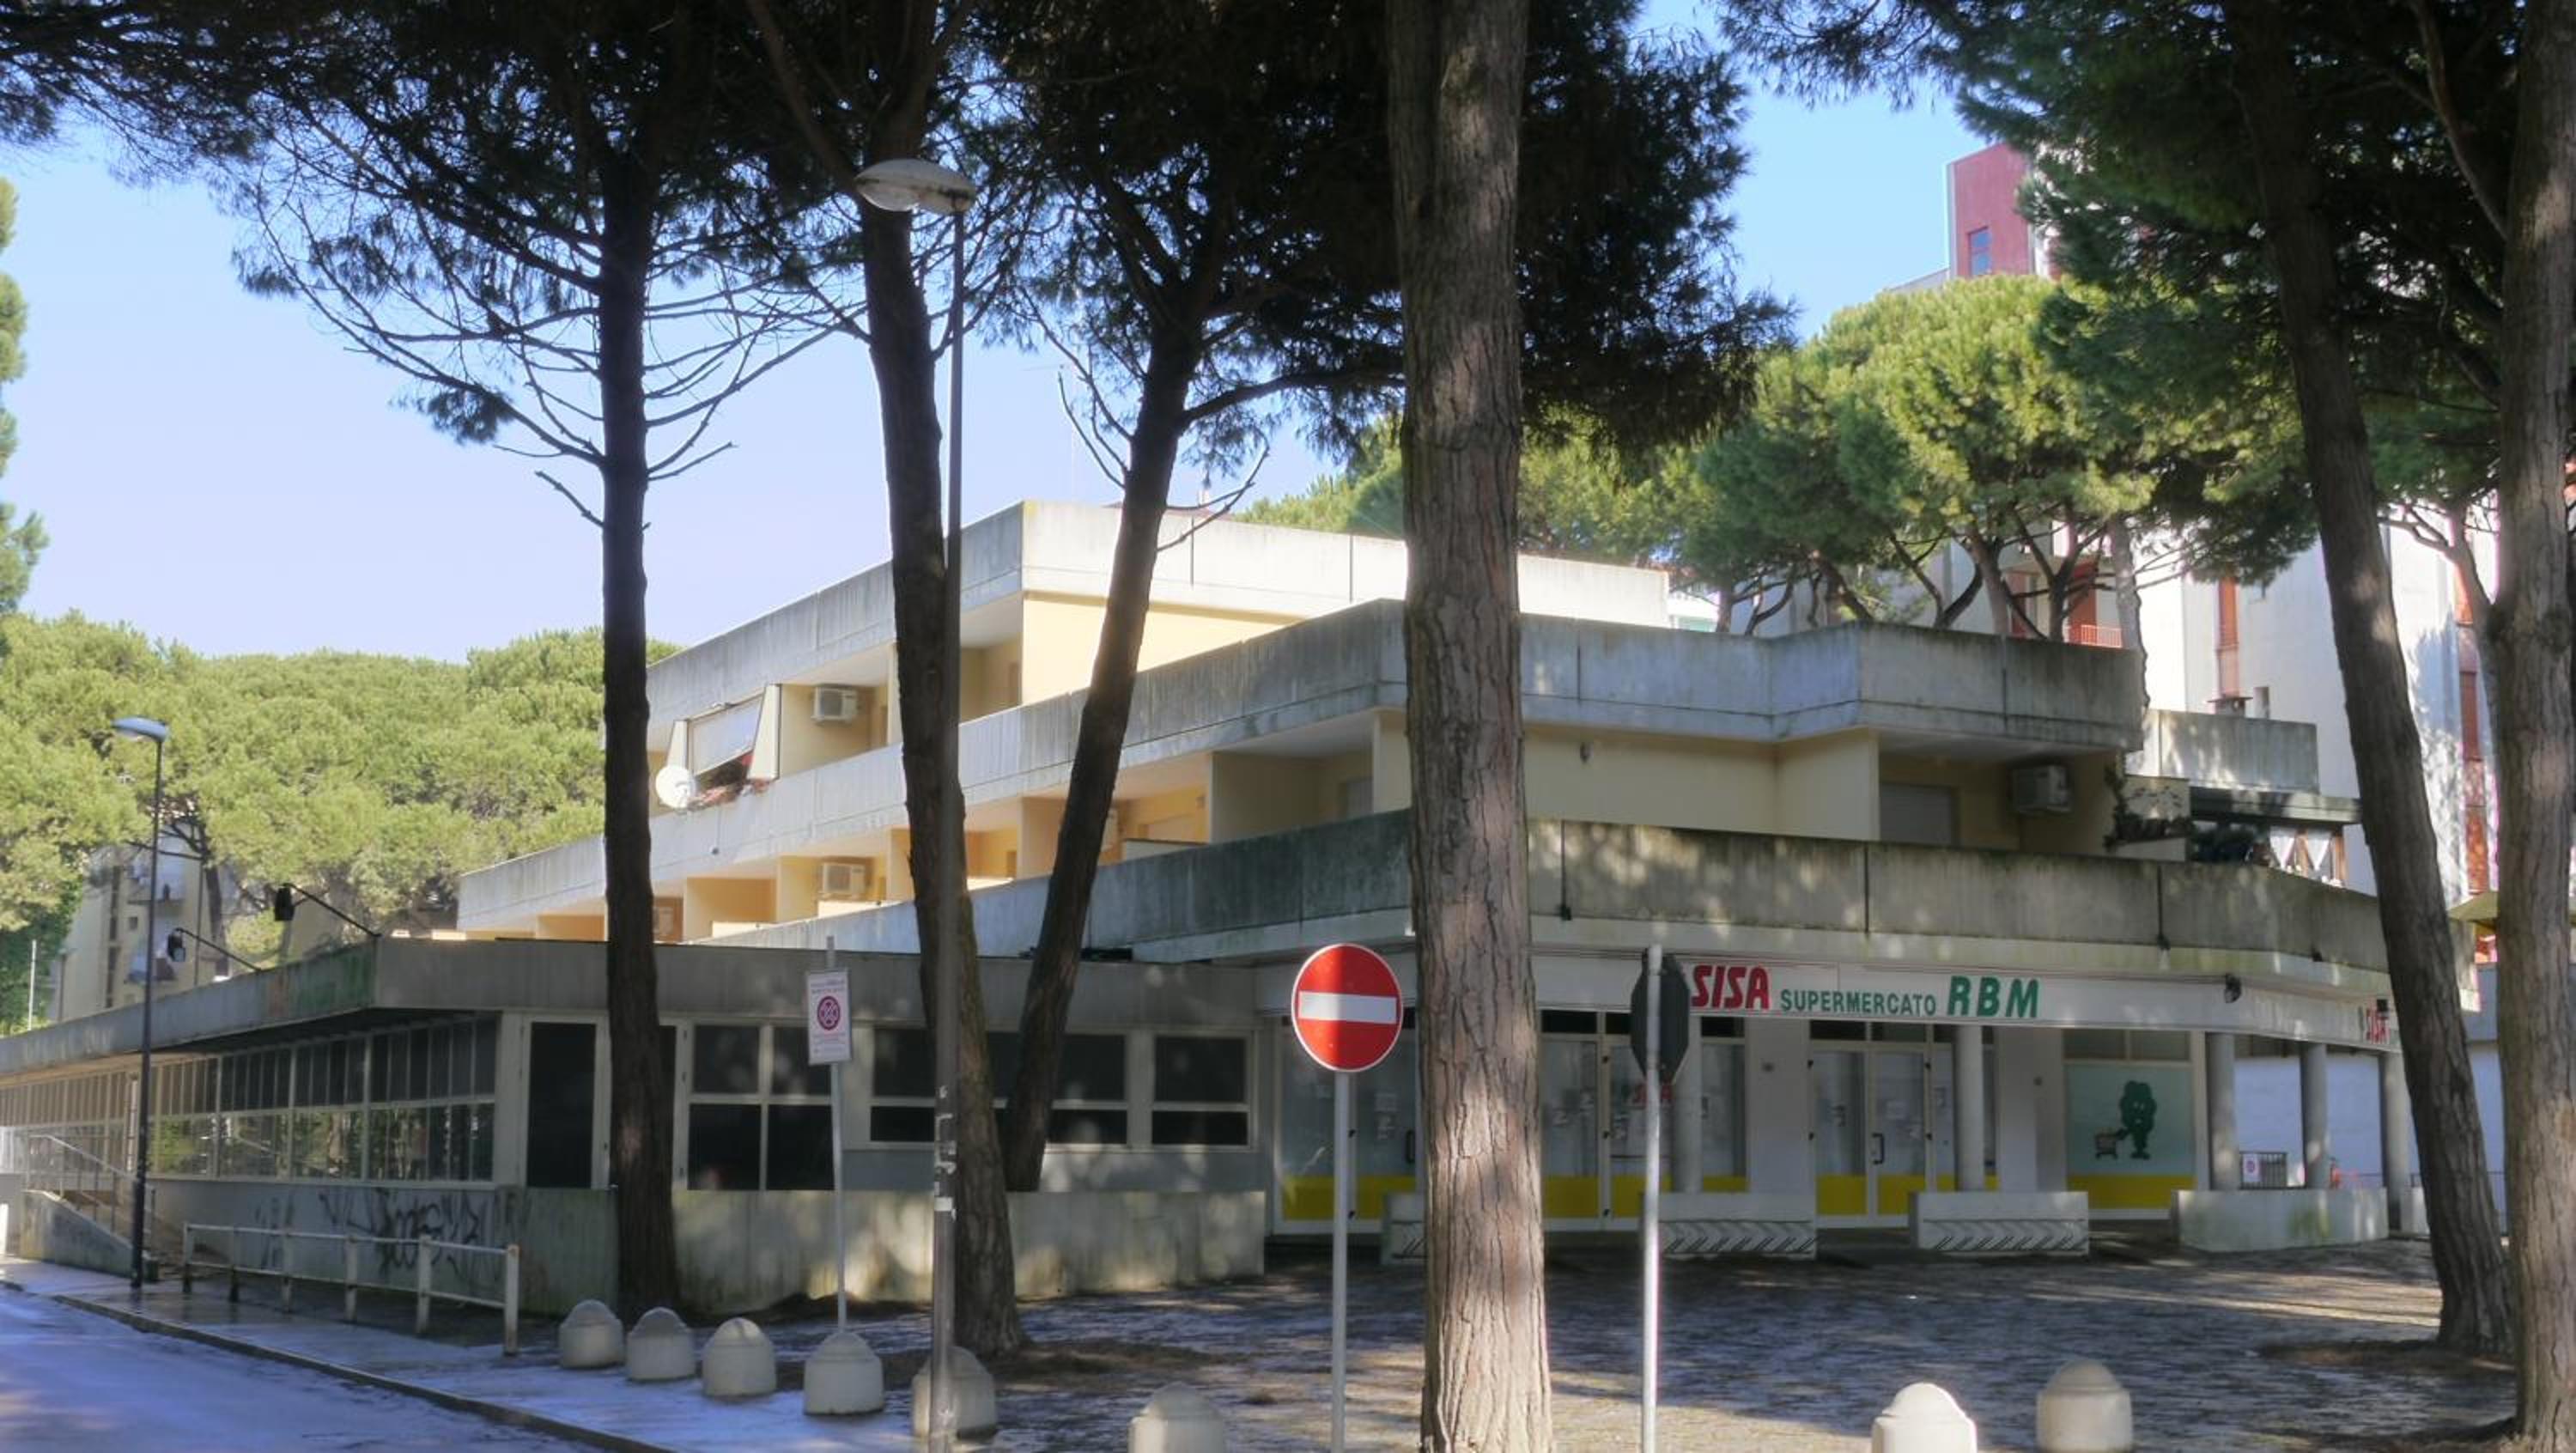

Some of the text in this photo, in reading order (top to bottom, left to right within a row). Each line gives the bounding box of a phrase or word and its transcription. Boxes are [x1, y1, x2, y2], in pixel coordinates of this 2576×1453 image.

[1692, 965, 2040, 1018] SISA SUPERMERCATO RBM
